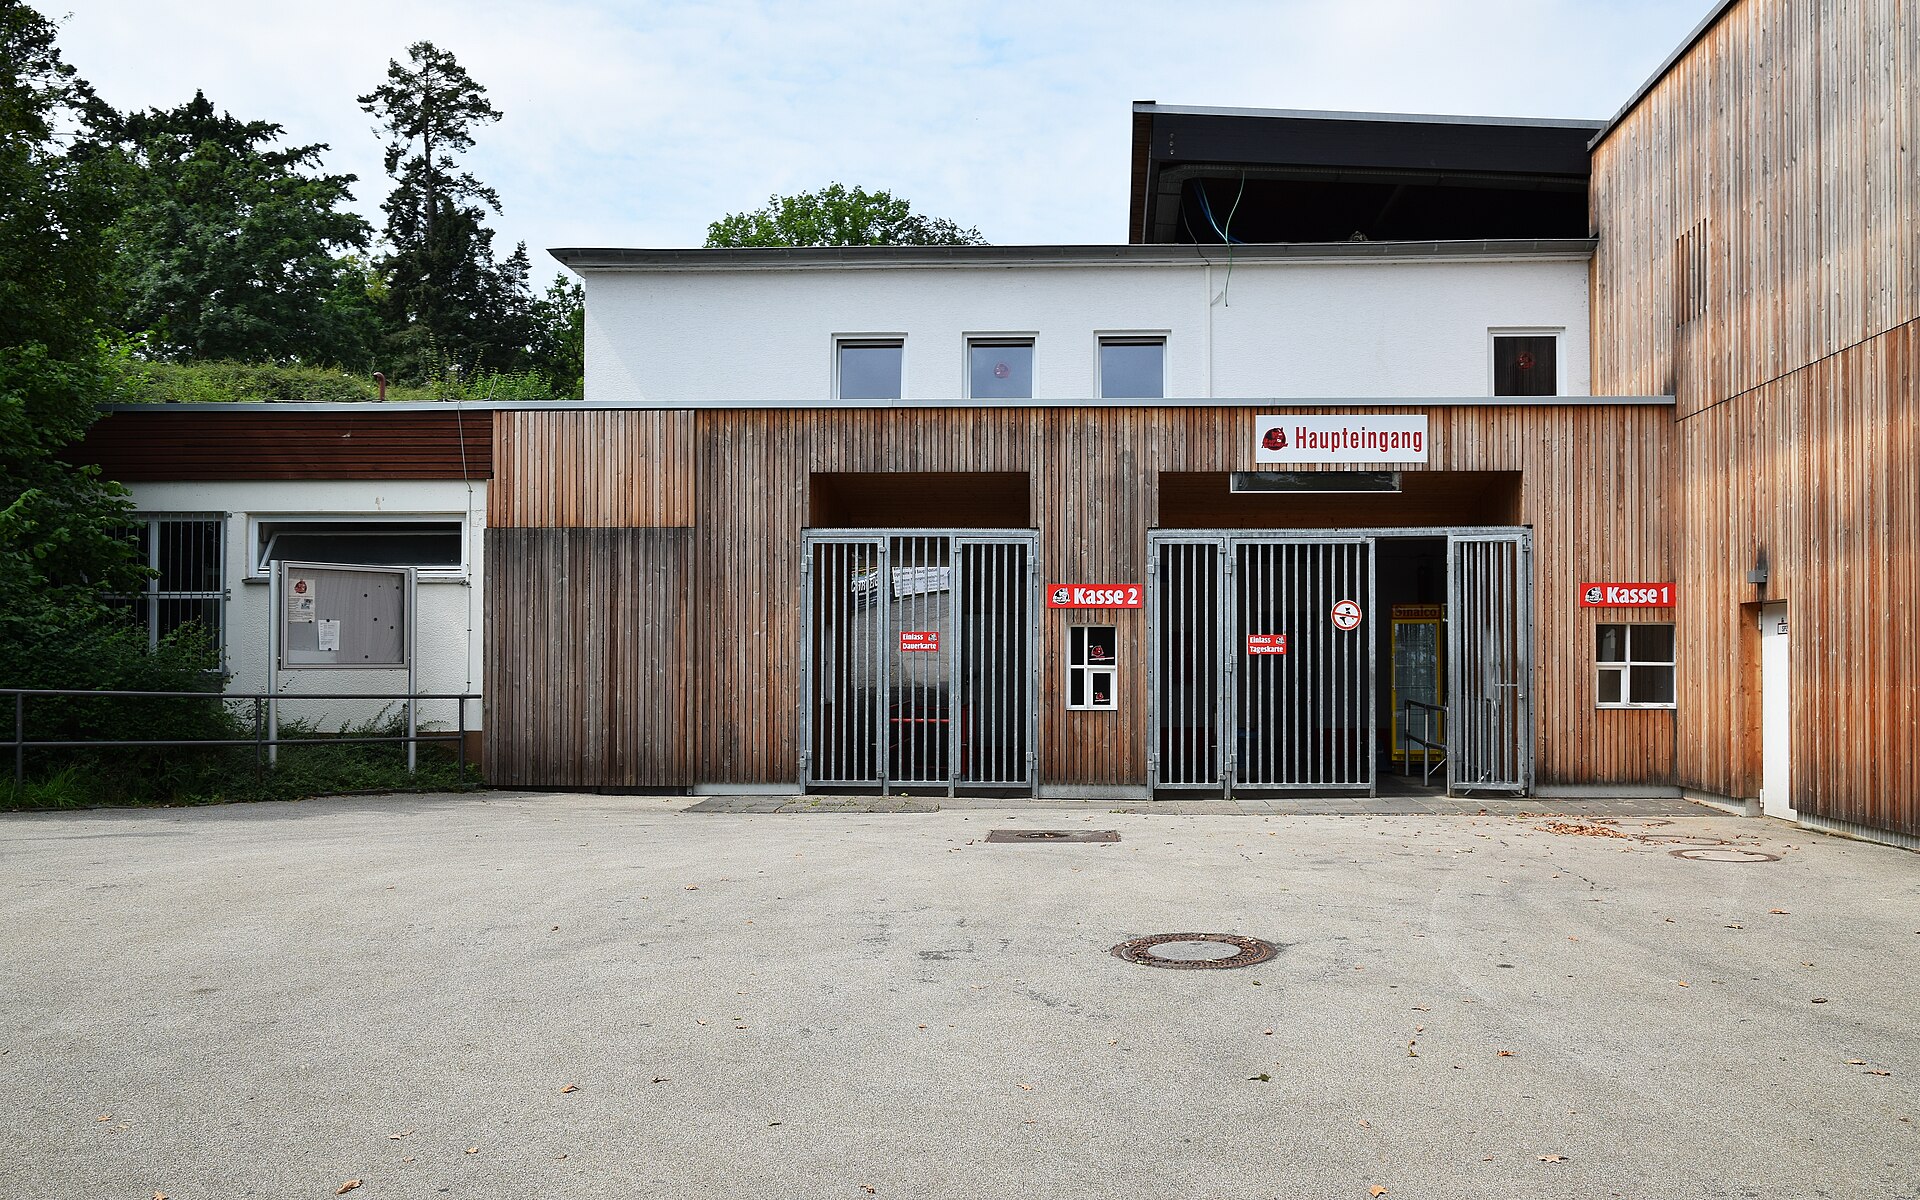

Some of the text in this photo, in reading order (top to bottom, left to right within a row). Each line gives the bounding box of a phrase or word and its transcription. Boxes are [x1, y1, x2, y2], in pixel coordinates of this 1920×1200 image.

[1295, 426, 1423, 453] Haupteingang
[1073, 587, 1124, 605] Kasse
[1127, 587, 1138, 605] 2
[1606, 586, 1668, 604] Kasse 1
[1394, 606, 1437, 617] Sinalco
[902, 633, 924, 641] Einlass
[1249, 636, 1271, 644] Einlass
[902, 642, 937, 650] Dauerkarte
[1249, 645, 1284, 654] Tageskarte
